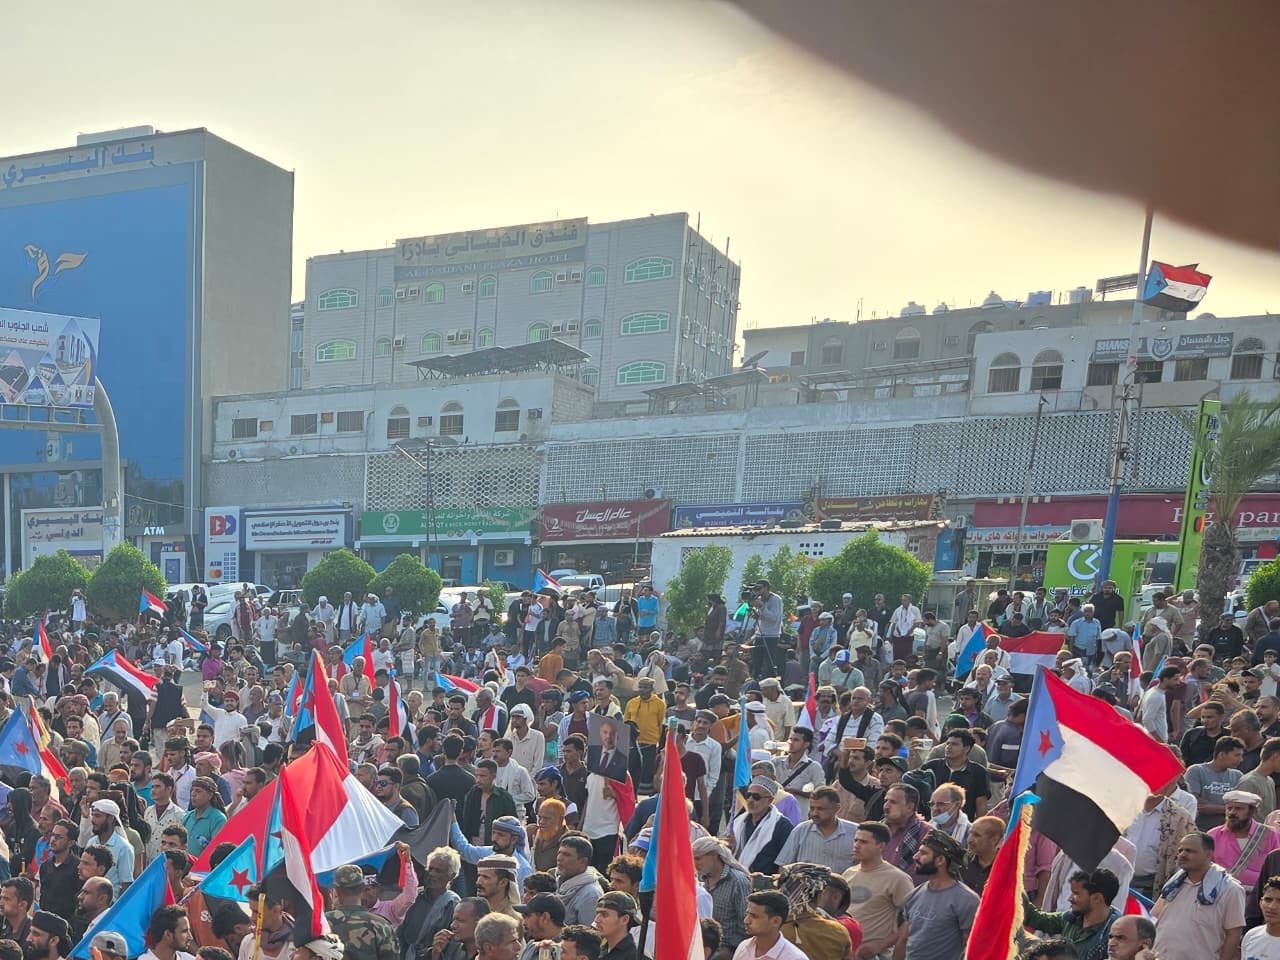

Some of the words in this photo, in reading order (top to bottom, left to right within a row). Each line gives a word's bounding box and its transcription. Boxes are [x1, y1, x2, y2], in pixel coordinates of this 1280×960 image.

[530, 224, 578, 249] فندق
[529, 254, 569, 266] HOTEL
[8, 320, 30, 332] الجنوب
[31, 321, 49, 333] شعب
[1180, 336, 1214, 346] شمسان
[1238, 511, 1280, 528] par
[143, 527, 166, 536] ATM
